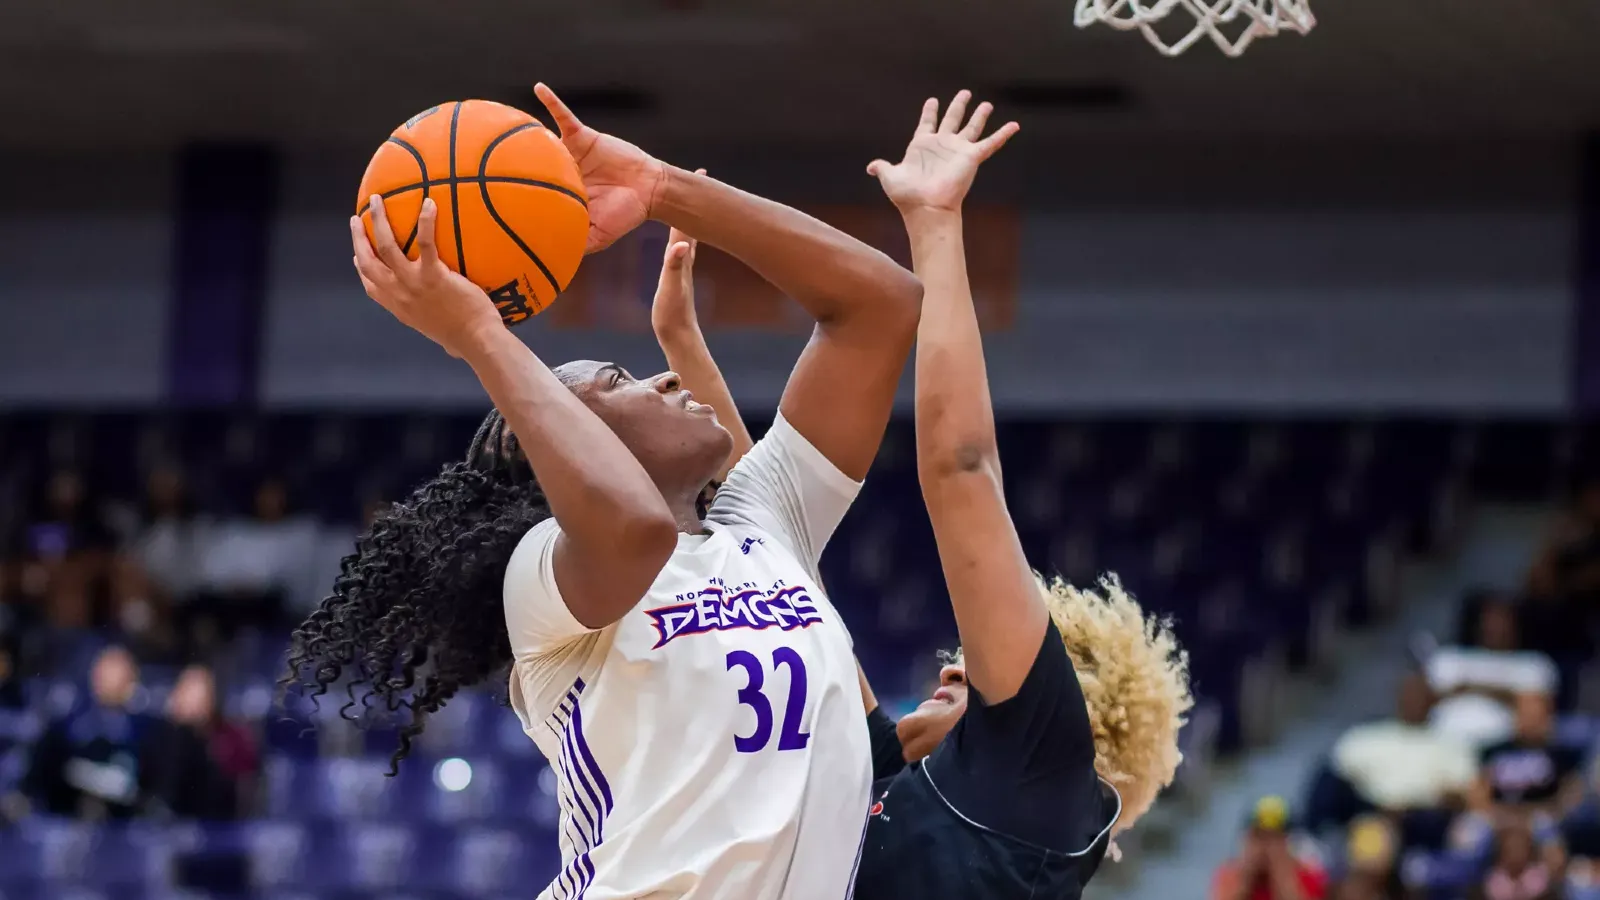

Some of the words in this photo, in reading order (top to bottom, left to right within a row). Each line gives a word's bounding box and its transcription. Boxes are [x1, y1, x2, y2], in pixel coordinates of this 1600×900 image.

[489, 278, 533, 326] CAA
[760, 579, 786, 598] TATE
[648, 586, 823, 648] DEMONS
[726, 646, 810, 753] 32
